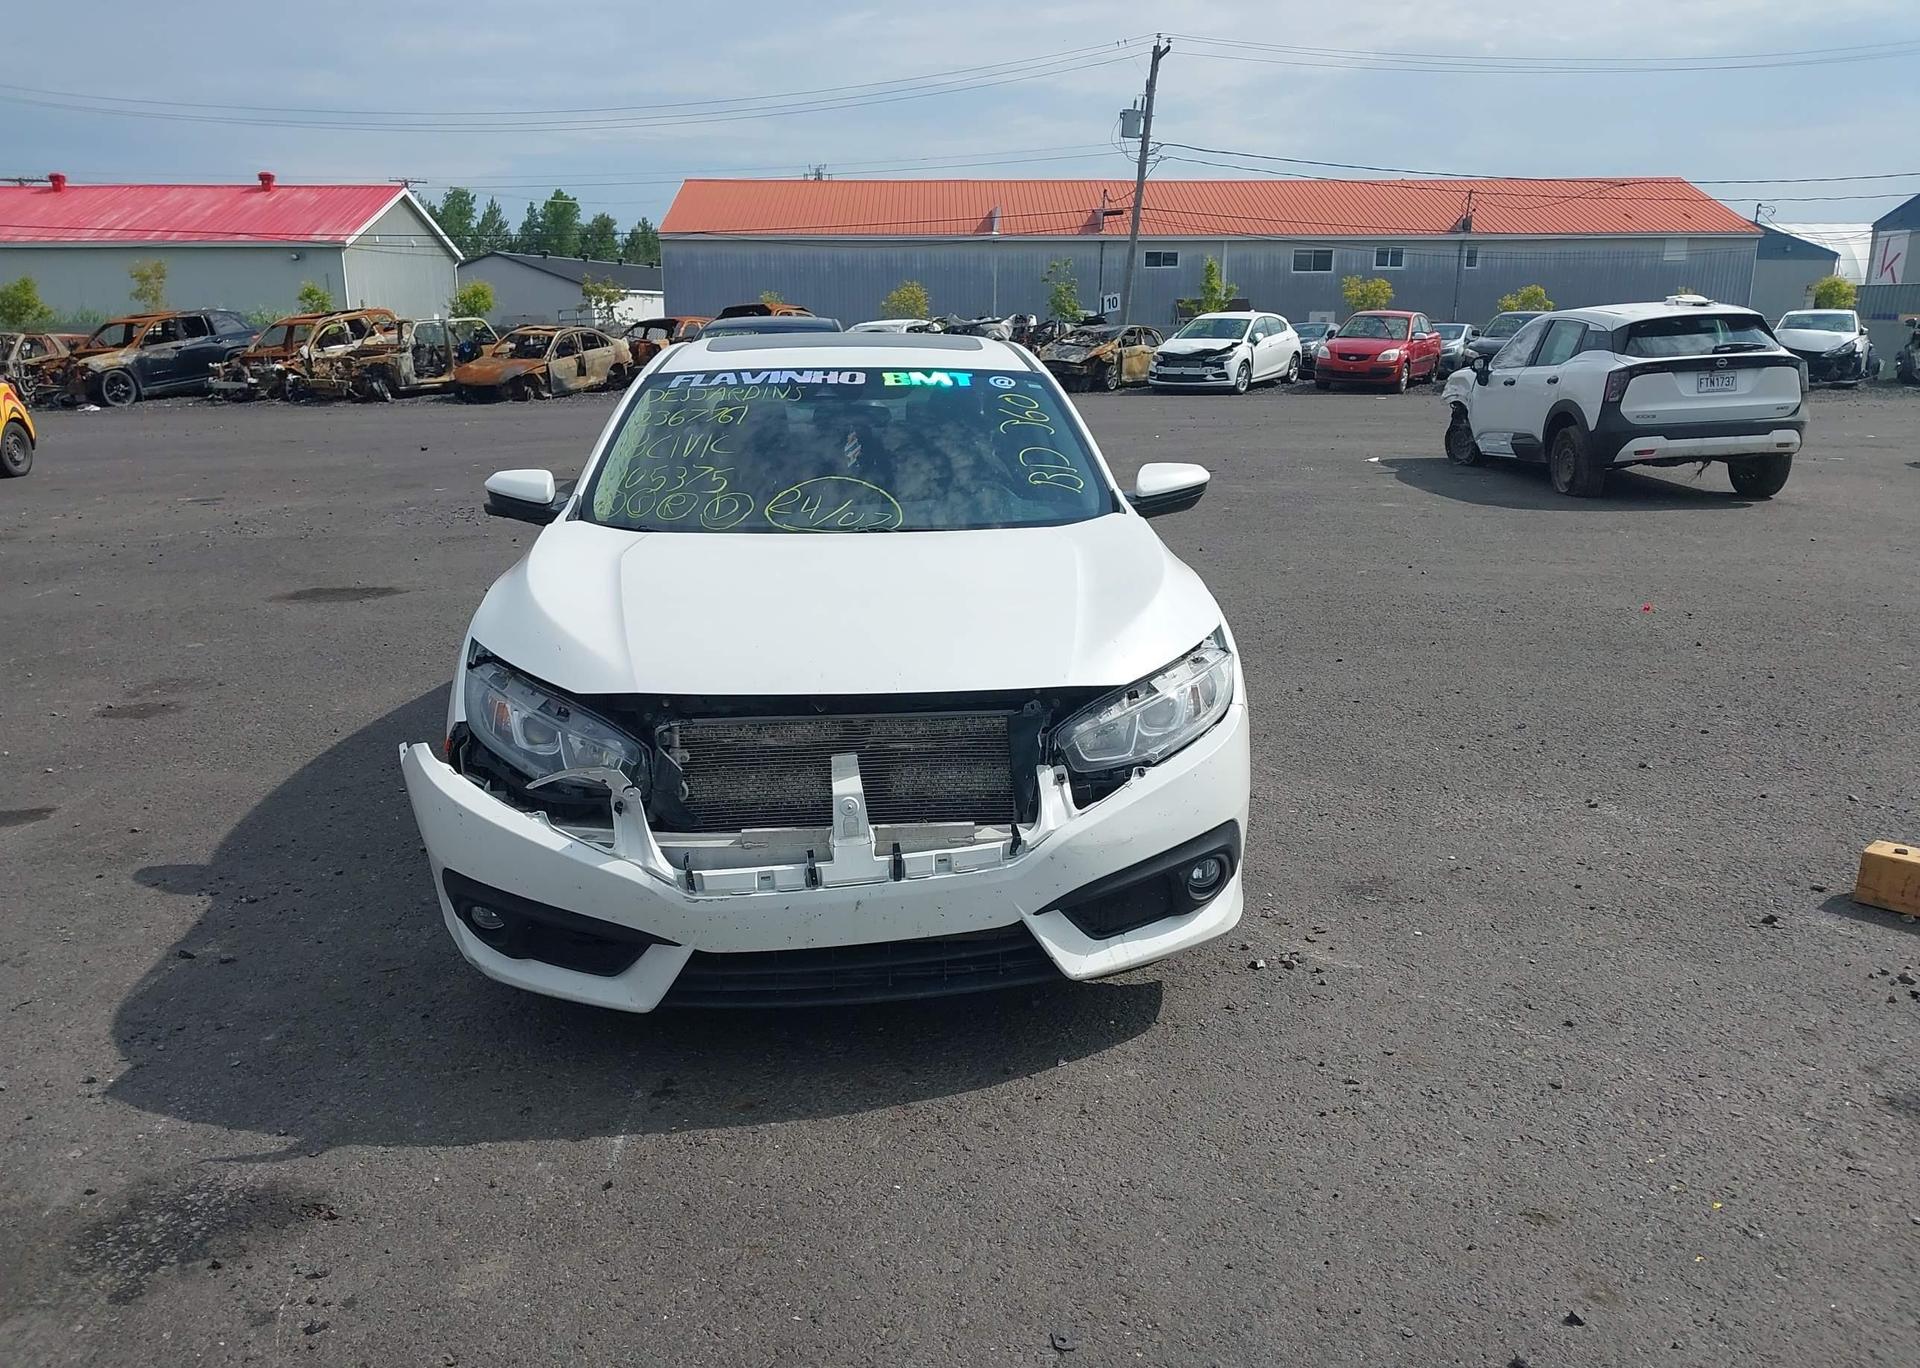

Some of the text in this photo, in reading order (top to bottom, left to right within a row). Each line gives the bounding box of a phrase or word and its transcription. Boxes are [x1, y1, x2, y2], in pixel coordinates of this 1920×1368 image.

[1106, 296, 1118, 309] 10
[668, 370, 867, 388] FLAVINHO
[881, 371, 974, 387] BMT
[1699, 375, 1736, 389] FTN1737
[648, 385, 807, 402] DESJARDINS
